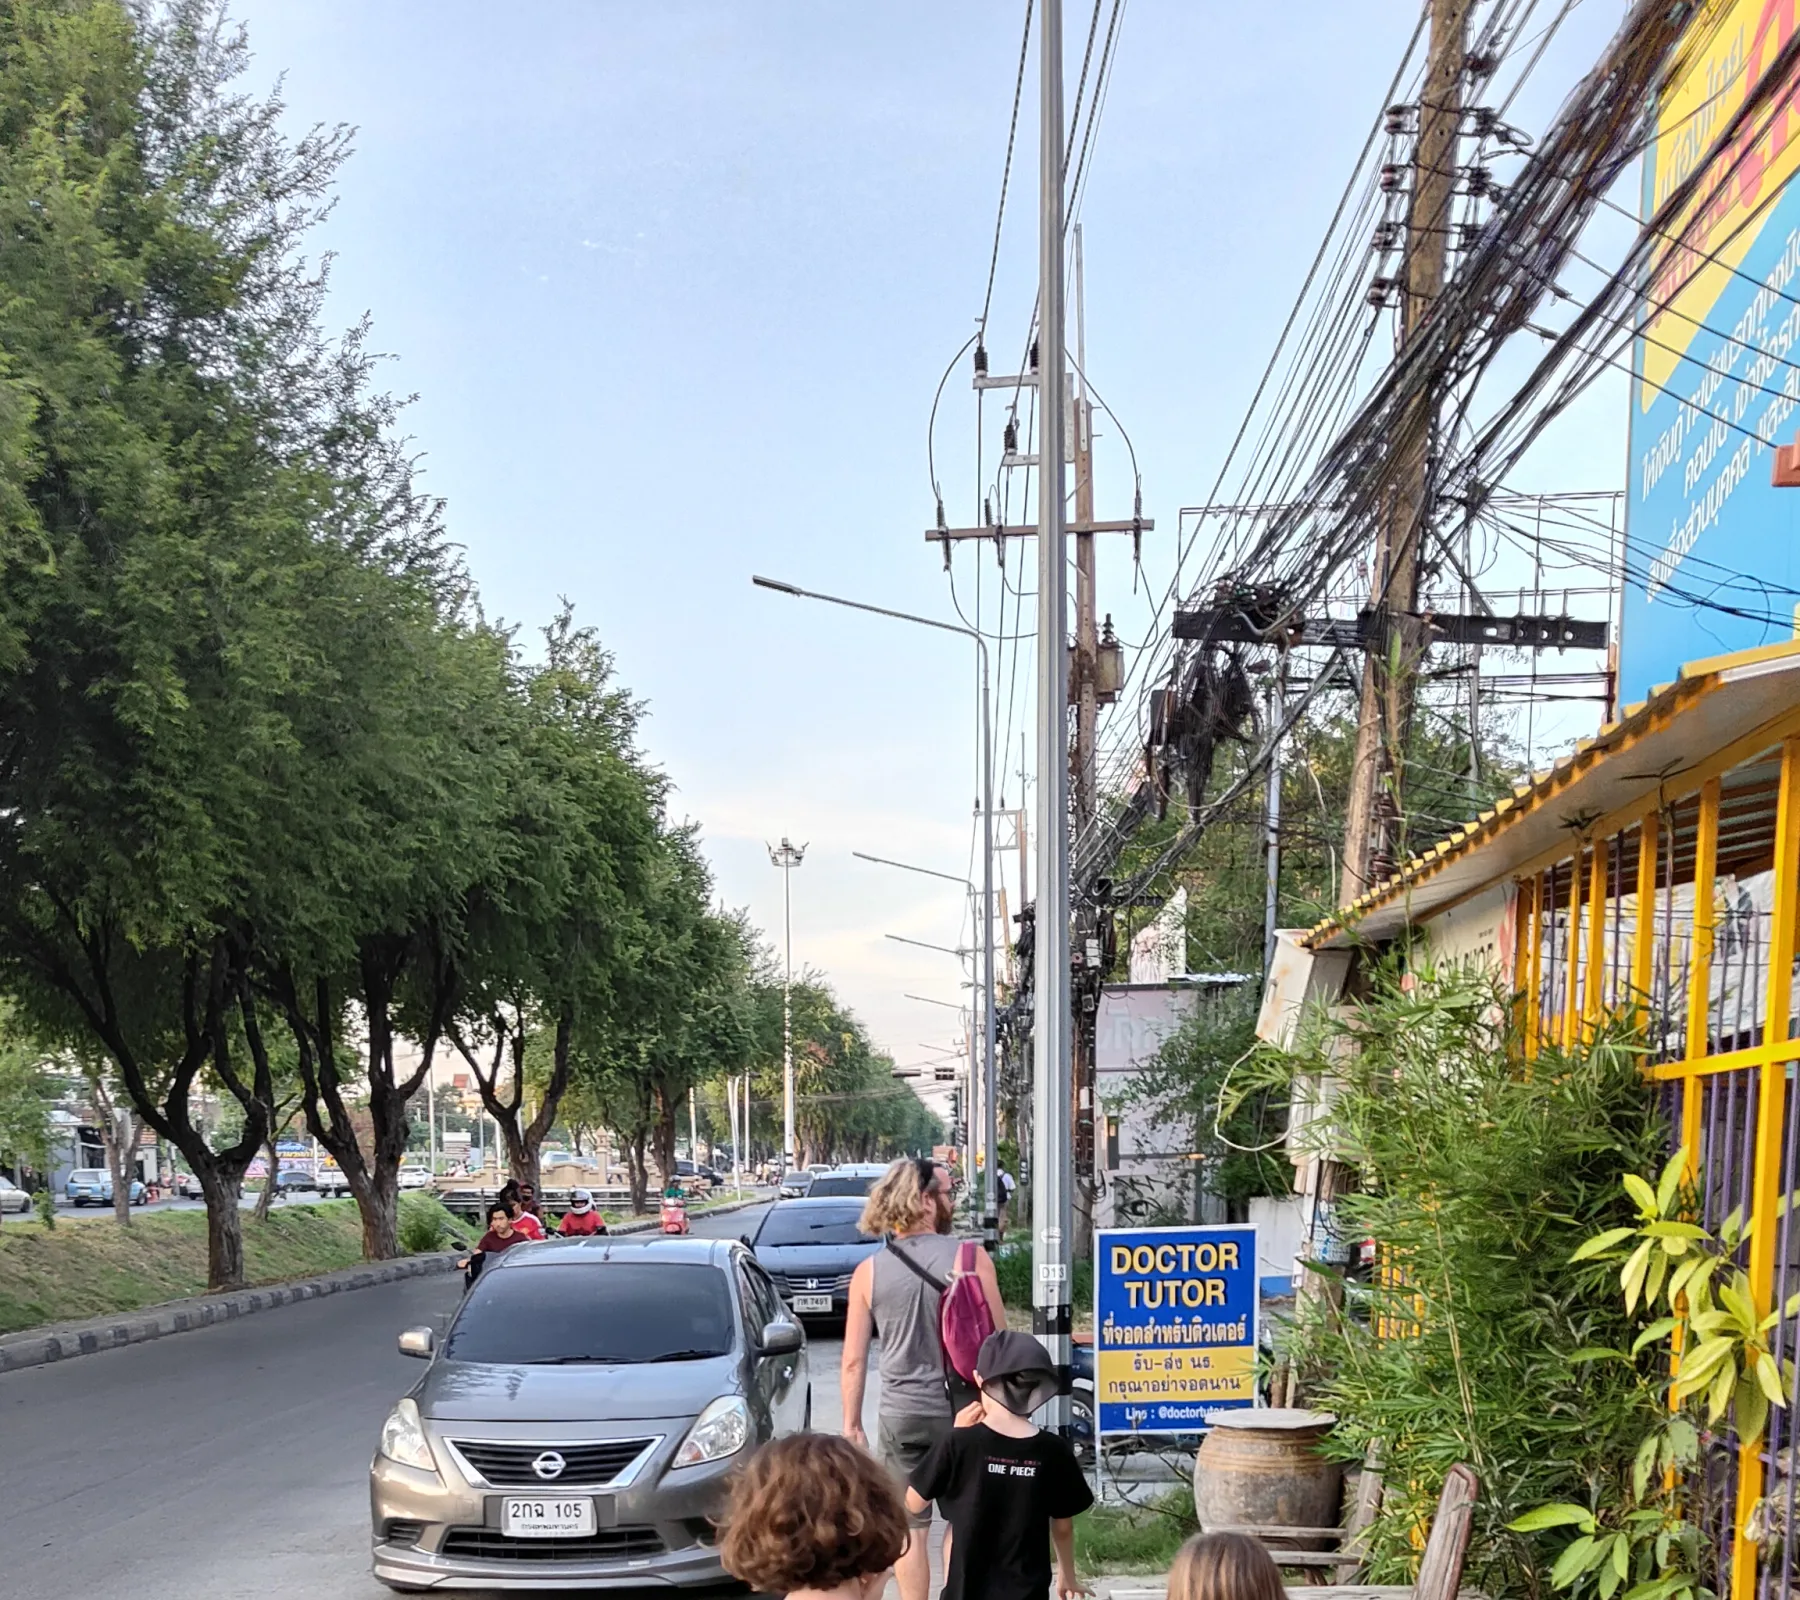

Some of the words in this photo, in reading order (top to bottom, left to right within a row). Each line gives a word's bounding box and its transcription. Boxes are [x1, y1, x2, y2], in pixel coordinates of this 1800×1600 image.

[1111, 1242, 1239, 1275] DOCTOR
[1124, 1278, 1226, 1309] TUTOR
[1102, 1310, 1248, 1345] ที่จอดสำหรับติวเตอร์
[1133, 1352, 1183, 1371] รับ-ส่ง
[1190, 1356, 1215, 1370] นร.
[1108, 1374, 1242, 1400] กรุณาอย่าจอดนาน
[988, 1463, 1007, 1475] ONE
[1010, 1466, 1036, 1477] PIECE
[555, 1503, 582, 1518] 105
